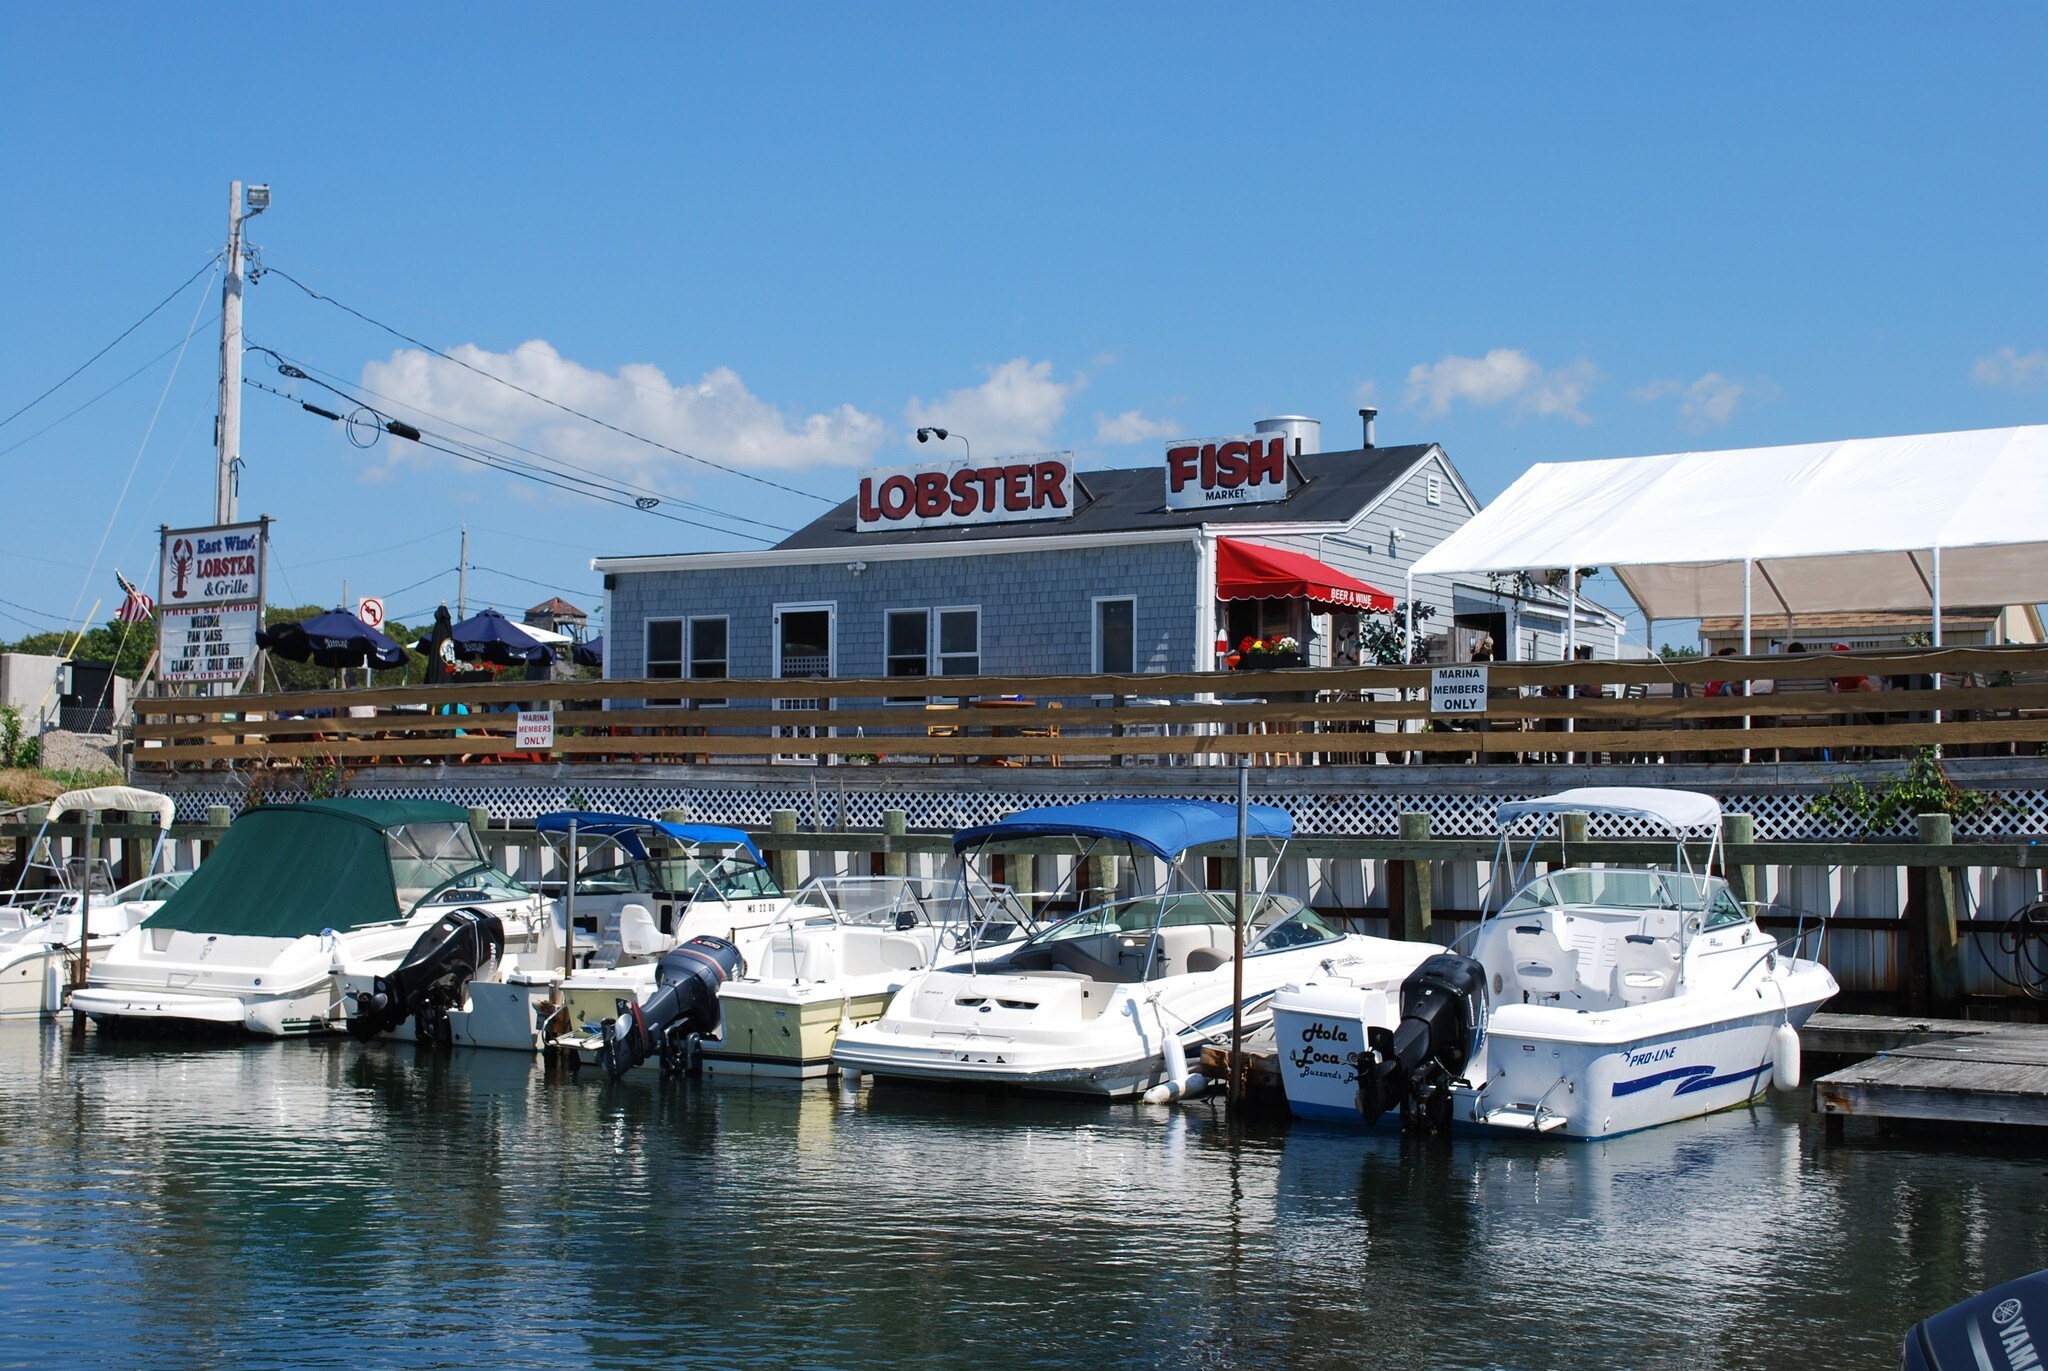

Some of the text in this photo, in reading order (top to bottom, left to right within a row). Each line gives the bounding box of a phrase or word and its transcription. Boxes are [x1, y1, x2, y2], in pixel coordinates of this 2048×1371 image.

[1167, 438, 1284, 493] FISH
[859, 460, 1068, 522] LOBSTER
[1205, 489, 1245, 501] MARKET
[197, 534, 256, 554] East Wind
[197, 555, 256, 579] LOBSTER
[1331, 588, 1372, 605] BEER & WINE
[165, 604, 256, 616] FRIED SEAFOOD
[191, 615, 220, 628] WELCOME
[187, 629, 222, 643] PAN MASS
[183, 643, 230, 658] KIDS PLATES
[171, 660, 194, 672] CLAMS
[207, 658, 223, 671] COLD
[228, 657, 244, 670] BEER
[163, 673, 188, 681] LIVE
[1439, 669, 1480, 679] MARINA
[1434, 684, 1485, 694] MEMBERS
[1444, 698, 1477, 710] ONLY
[518, 725, 552, 733] MEMBERS
[524, 736, 546, 745] ONLY
[1302, 1022, 1348, 1042] Hola
[1295, 1045, 1340, 1068] Loca
[1300, 1066, 1342, 1079] Buzzards
[1999, 1316, 2044, 1371] YAM
